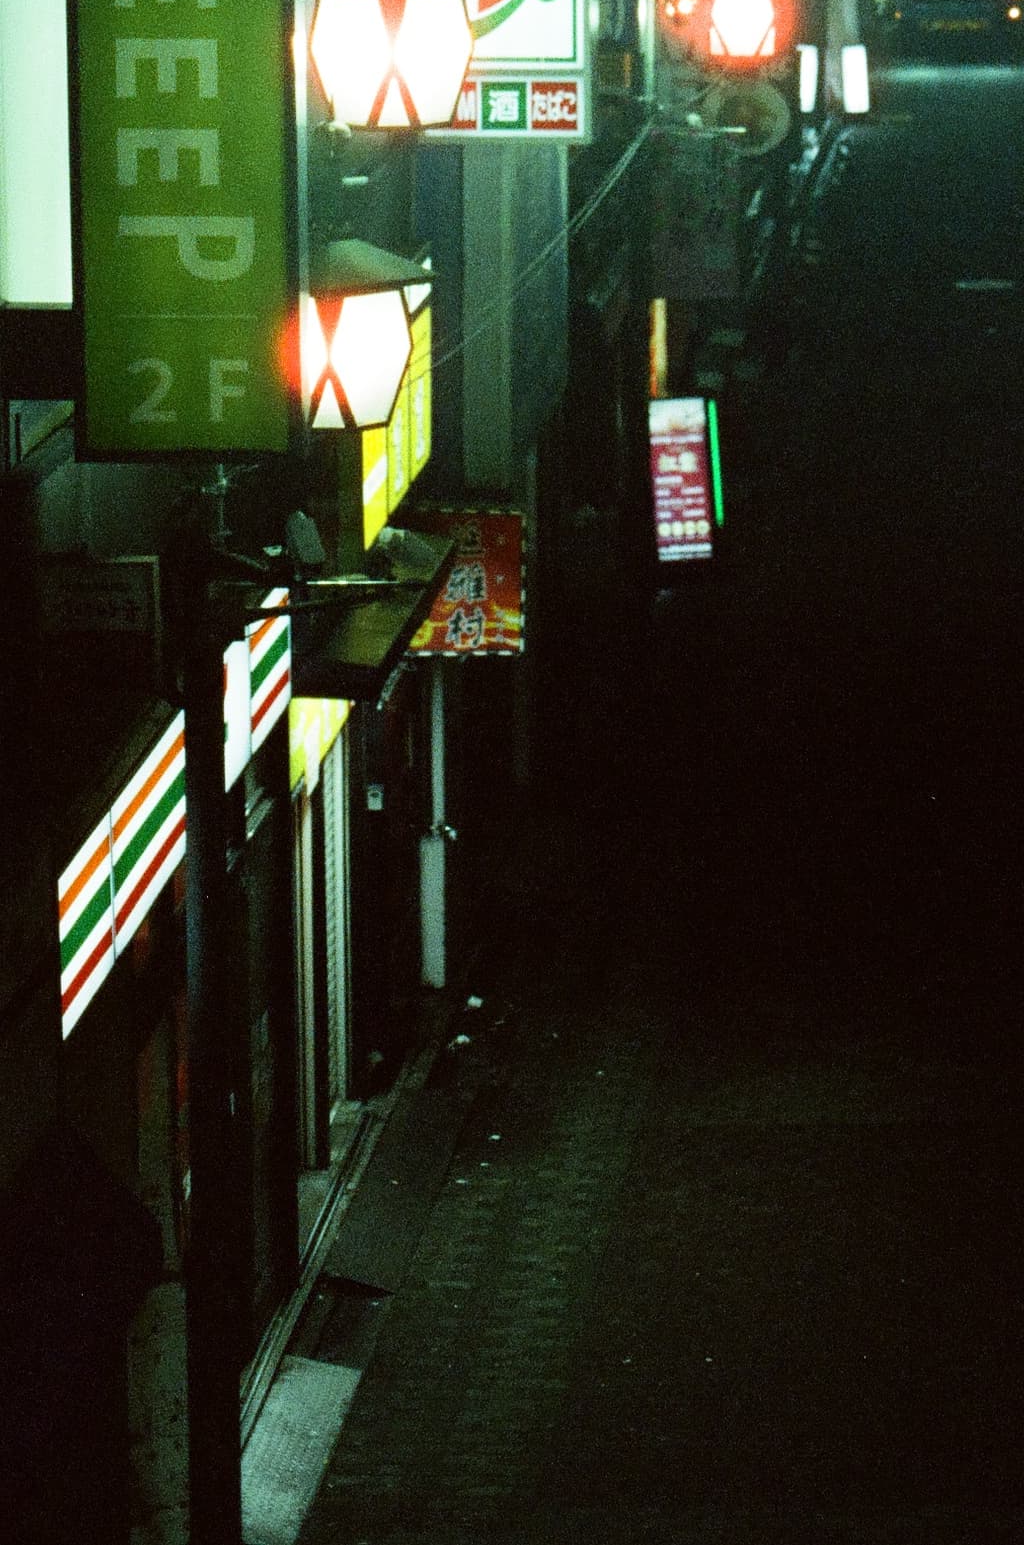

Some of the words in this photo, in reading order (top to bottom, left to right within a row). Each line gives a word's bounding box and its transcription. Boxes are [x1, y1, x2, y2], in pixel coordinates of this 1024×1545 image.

[489, 90, 519, 122] 酒
[532, 90, 577, 123] たばこ
